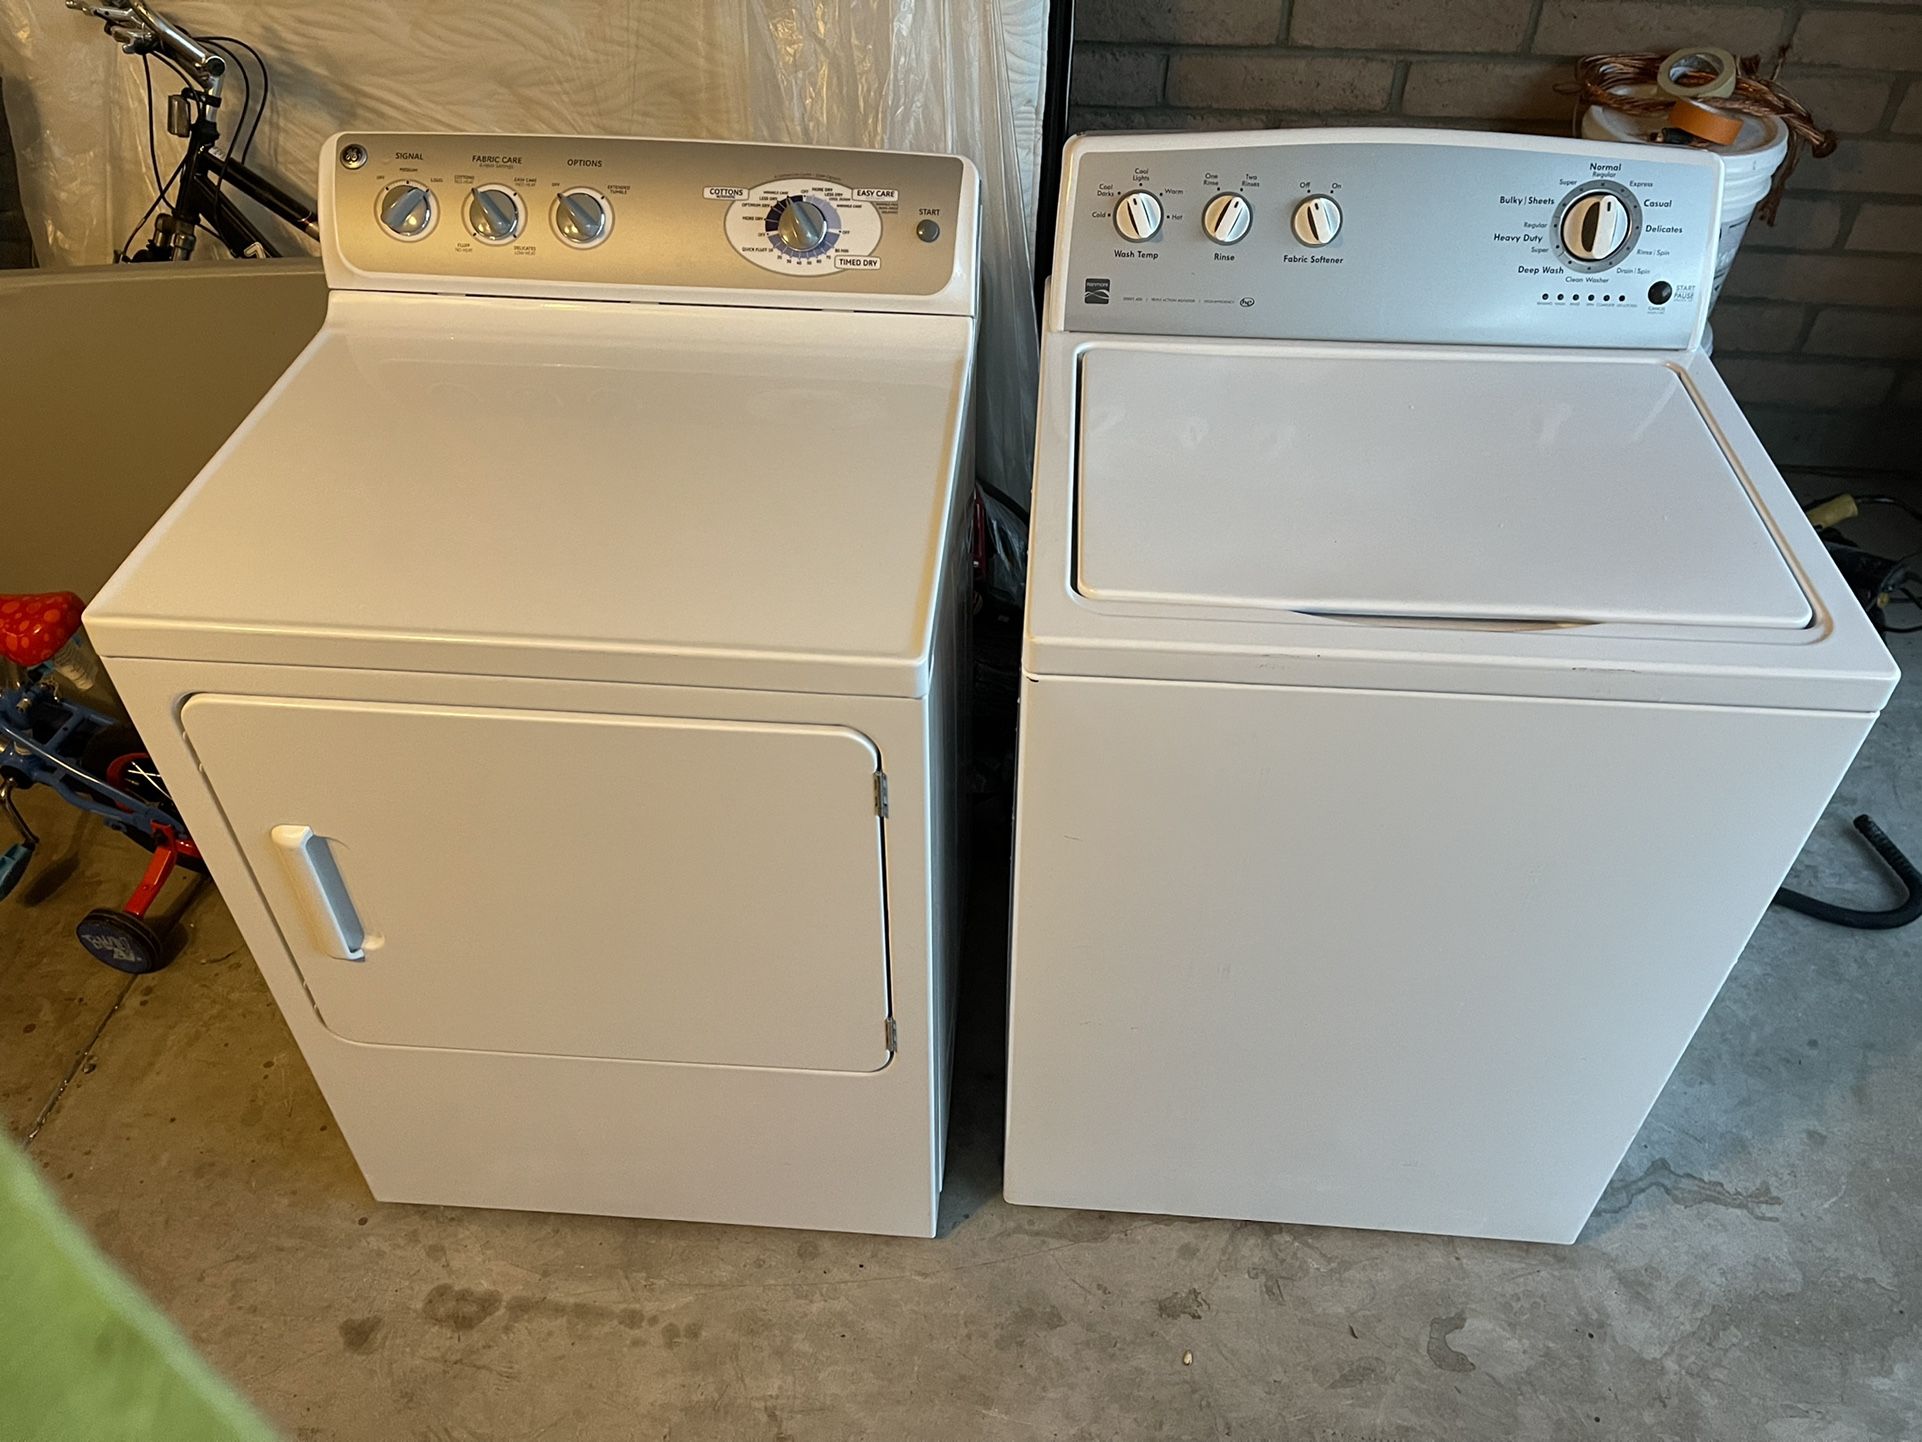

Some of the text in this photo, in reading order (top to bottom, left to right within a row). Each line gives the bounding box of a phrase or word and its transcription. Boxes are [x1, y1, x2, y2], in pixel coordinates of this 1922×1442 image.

[395, 152, 423, 160] SIGNAL
[472, 155, 522, 164] FABRIC CARE
[567, 158, 602, 167] OPTIONS
[1589, 163, 1621, 171] Normal
[1559, 178, 1578, 186] Super
[1629, 180, 1653, 188] Express
[709, 188, 743, 196] COTTONS
[876, 190, 895, 198] CARE
[1643, 199, 1672, 208] Casual
[1524, 221, 1548, 229] Regular
[1645, 224, 1683, 234] Delicates
[1493, 233, 1543, 243] Heavy Duty
[1531, 246, 1549, 254] Super
[1114, 250, 1159, 260] Wash Temp
[1214, 253, 1235, 261] Rinse
[863, 259, 878, 267] DRY
[1283, 255, 1344, 264] Fabric Softener
[1518, 265, 1564, 275] Deep Wash
